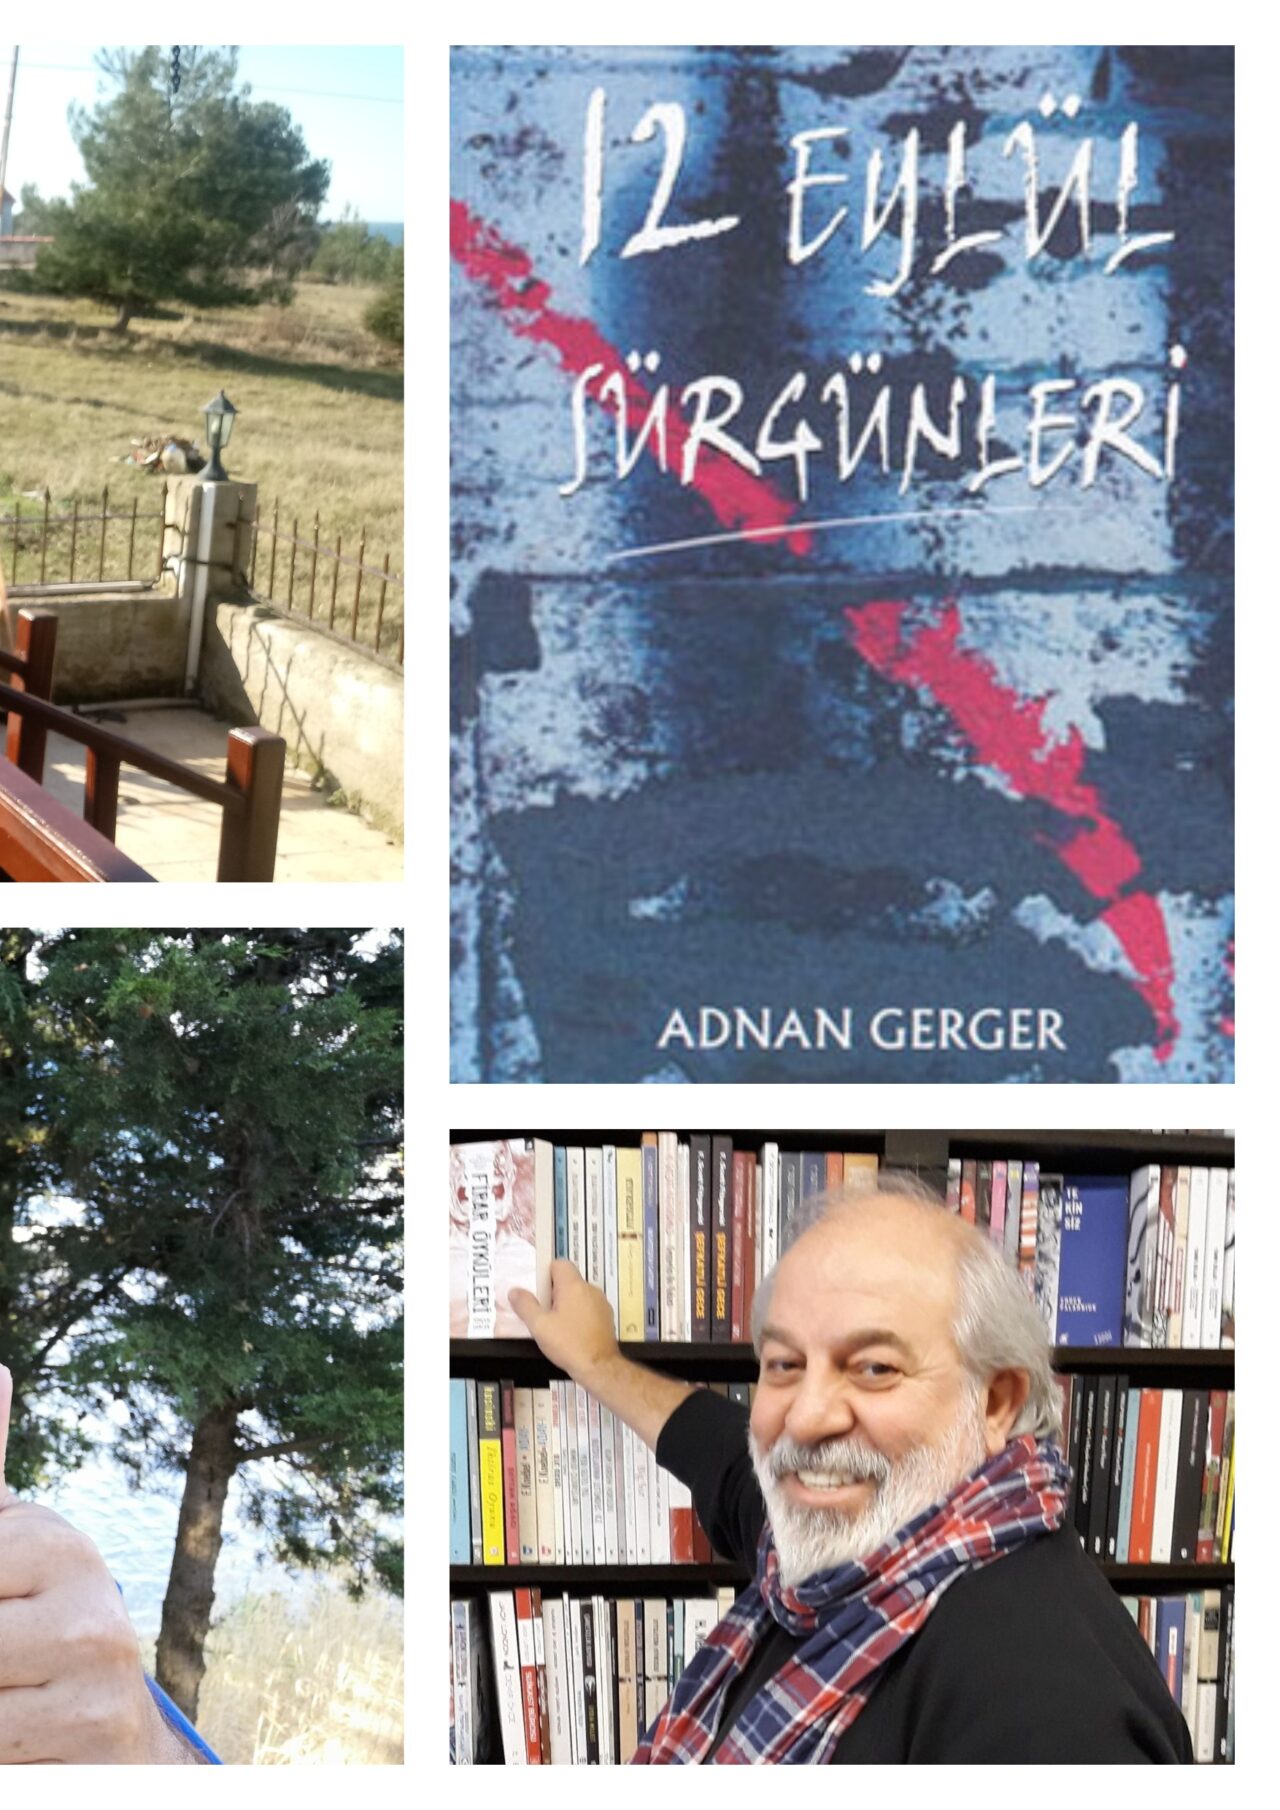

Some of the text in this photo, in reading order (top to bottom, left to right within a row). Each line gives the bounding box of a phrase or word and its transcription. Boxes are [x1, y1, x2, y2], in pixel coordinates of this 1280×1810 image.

[579, 88, 1175, 298] 12 EYLÜL
[558, 344, 1188, 501] SÜRGÜNLERİ
[657, 1008, 1067, 1050] ADNAN GERGER
